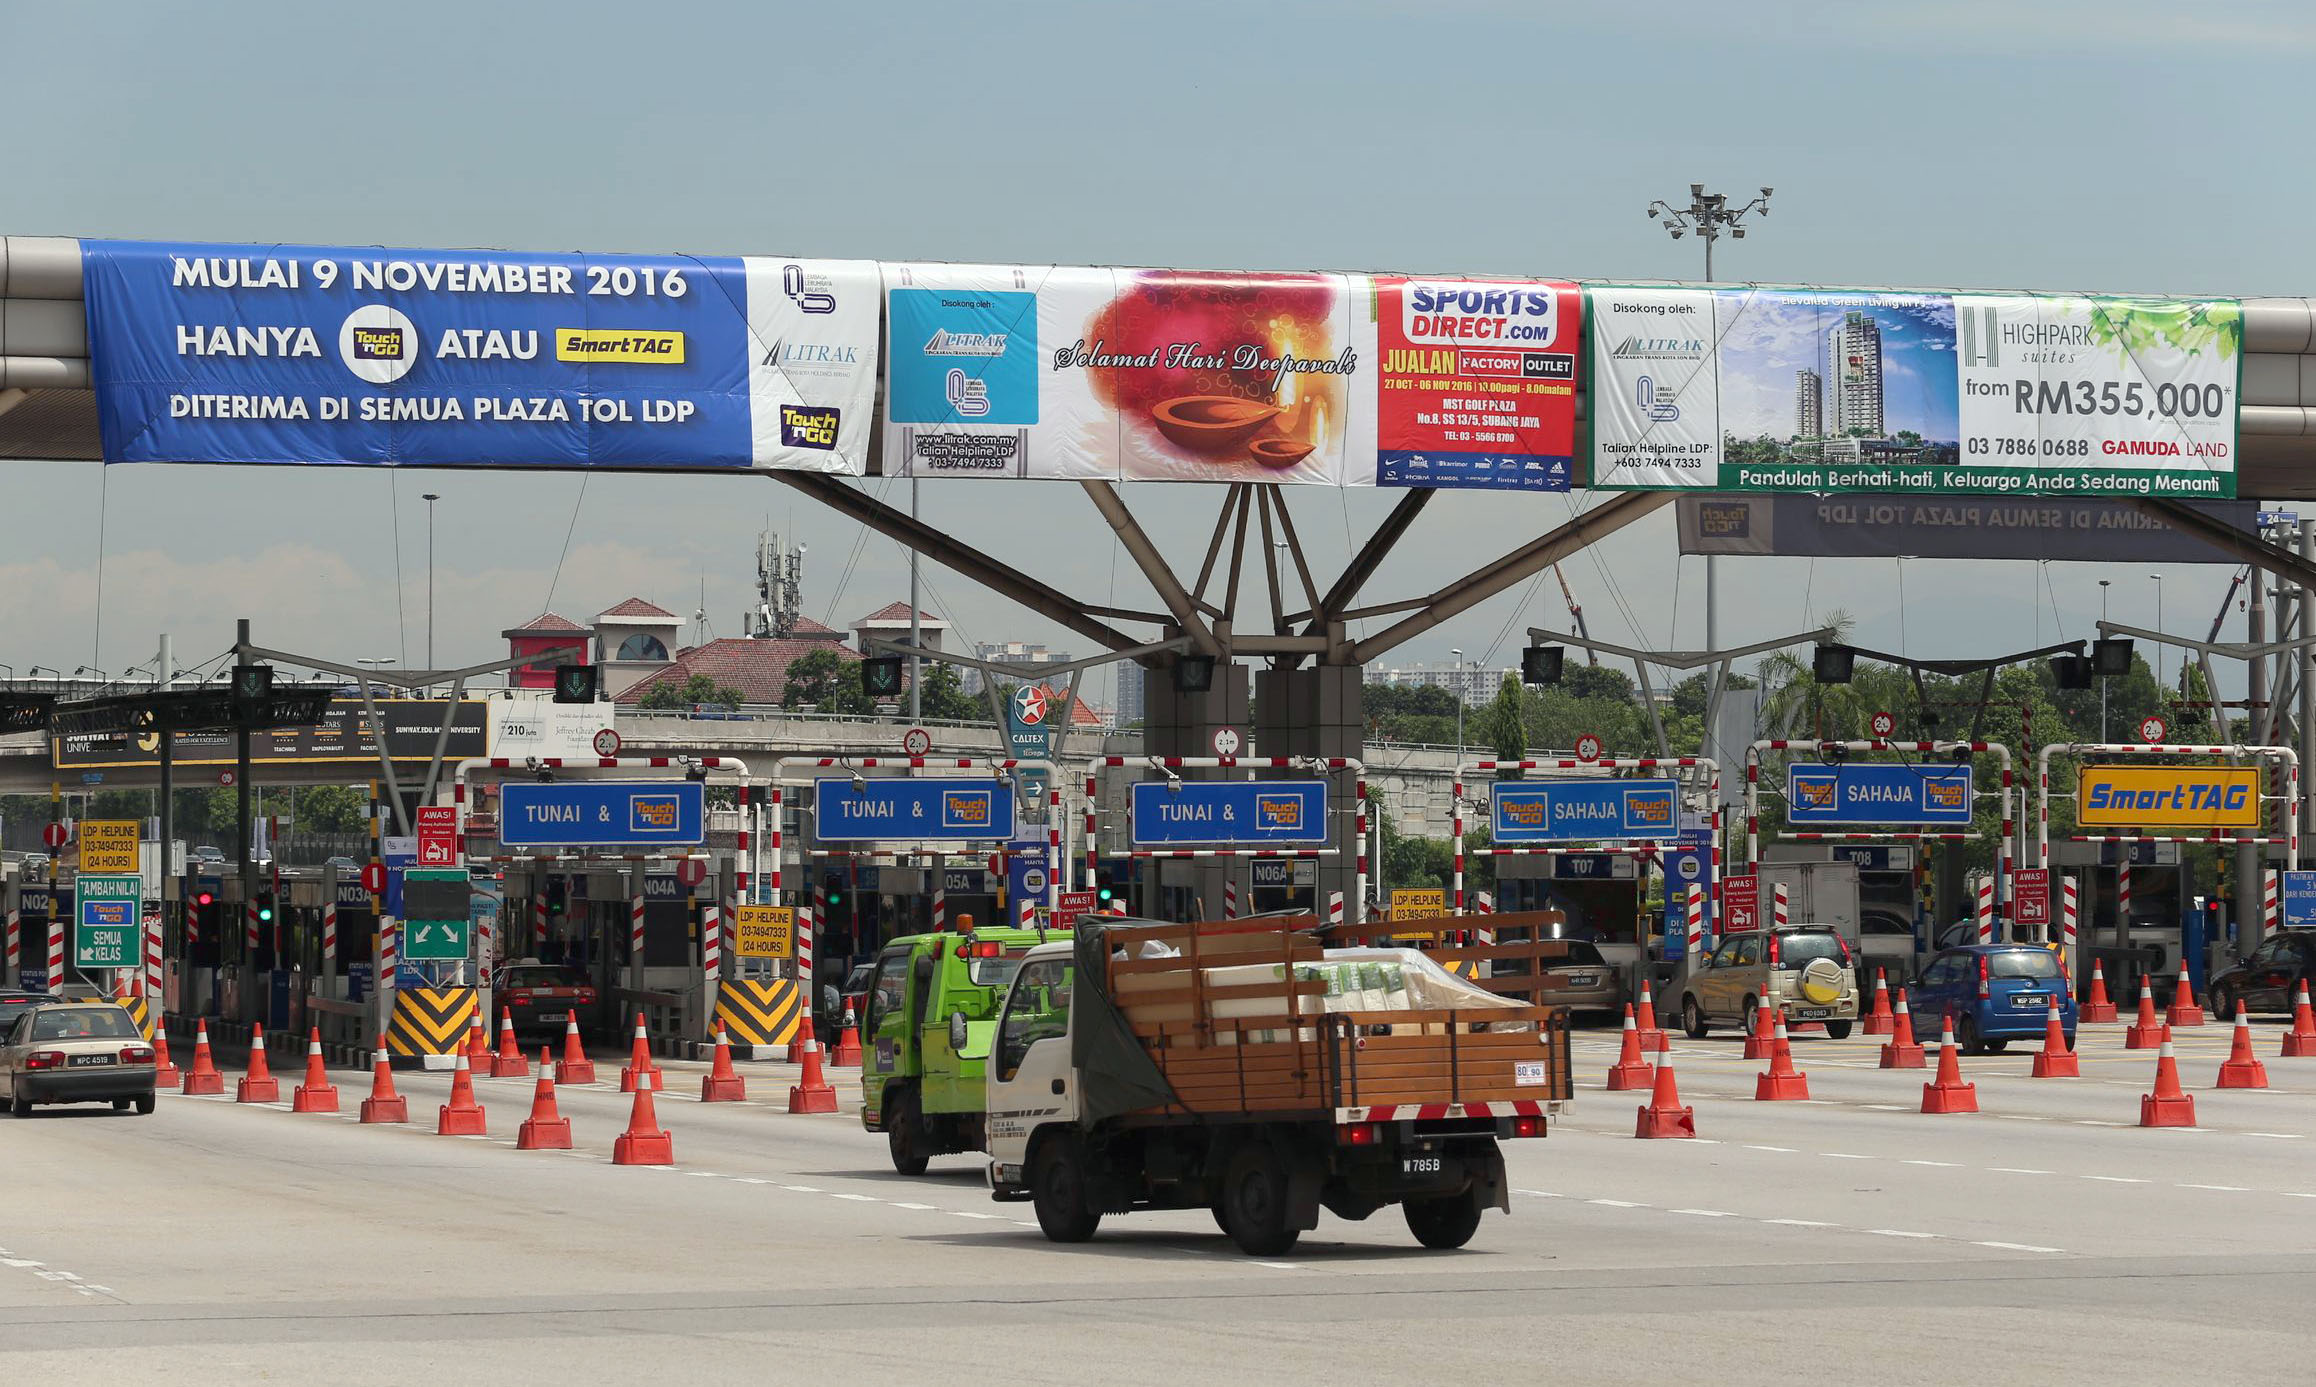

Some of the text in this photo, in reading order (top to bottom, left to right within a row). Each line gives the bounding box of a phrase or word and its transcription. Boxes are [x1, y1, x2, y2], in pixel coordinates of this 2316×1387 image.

[171, 257, 688, 298] MULAI 9 NOVEMBER 2016
[941, 299, 975, 309] Disokong
[1411, 286, 1549, 316] SPORTS
[1613, 302, 1697, 316] Disokong oleh:
[1411, 315, 1549, 341] DIRECT.COM
[2003, 323, 2095, 347] HIGHPARK
[176, 325, 538, 360] HANYA ATAU
[354, 330, 403, 345] Touch
[945, 333, 1006, 348] LITRAK
[1636, 338, 1705, 351] LITRAK
[565, 337, 673, 355] SmartTAG
[784, 344, 858, 363] LITRAK
[1382, 348, 1456, 375] JUALAN
[2021, 347, 2076, 365] suites
[1053, 339, 1359, 392] Selamat Hari Deepavali
[1462, 357, 1520, 371] FACTORY
[1525, 359, 1571, 373] OUTLET
[1384, 378, 1396, 389] 27
[1419, 379, 1432, 390] 06
[1433, 380, 1451, 390] NOV
[1451, 381, 1473, 392] 2016
[1966, 378, 2010, 397] from
[170, 394, 695, 423] DITERIMA DI SEMUA PLAZA TOL LDP
[1443, 398, 1517, 412] MST GOLF PLAZA
[783, 409, 837, 429] Touch
[1442, 413, 1455, 425] SS
[1482, 415, 1519, 428] SUBANG
[1519, 416, 1541, 429] JAYA
[915, 433, 1016, 447] www.litrak.com.my
[1968, 436, 2089, 457] 03 7886 0688
[950, 446, 995, 458] Helpline
[996, 447, 1015, 457] LDP
[1602, 442, 1713, 456] Talian Helpline LDP:
[2101, 439, 2228, 458] GAMUDA LAND
[933, 457, 1003, 468] 03-7494 7333
[1615, 457, 1702, 469] +603 7494 7333
[1739, 469, 2220, 493] Pandulah Berhati-hati, Keluarga Anda Sedang Menanti
[507, 725, 525, 736] 210
[1012, 734, 1045, 744] CALTEX
[1797, 781, 1964, 803] Touch SAHAJA Touch
[2087, 783, 2249, 811] SmartTAG
[526, 801, 675, 823] TUNAI & Touch
[840, 797, 987, 818] TUNAI & Touch
[1159, 800, 1299, 822] TUNAI & Touch
[1501, 799, 1670, 820] Touch SAHAJA Touch
[83, 825, 135, 838] LDP HELPLINE
[84, 841, 134, 852] 03-74947333
[87, 856, 131, 868] (24 HOURS)
[1849, 850, 1872, 867] T08
[1255, 866, 1287, 882] N06A
[1571, 858, 1594, 876] T07
[944, 870, 970, 890] 05A
[1728, 879, 1753, 889] AWAS!
[80, 880, 138, 897] TAMBAH NILAI
[337, 886, 372, 902] N03A
[1064, 896, 1091, 905] AWAS!
[1394, 894, 1441, 906] LDP HELPLINE
[93, 904, 124, 915] Touch
[1395, 908, 1440, 920] 03-74947333
[740, 911, 789, 924] LDP HELPLINE
[93, 931, 123, 945] SEMUA
[741, 926, 787, 938] 03-74947333
[95, 946, 122, 961] KELAS
[743, 941, 784, 953] (24 HOURS)
[1403, 1158, 1440, 1172] W 785B
